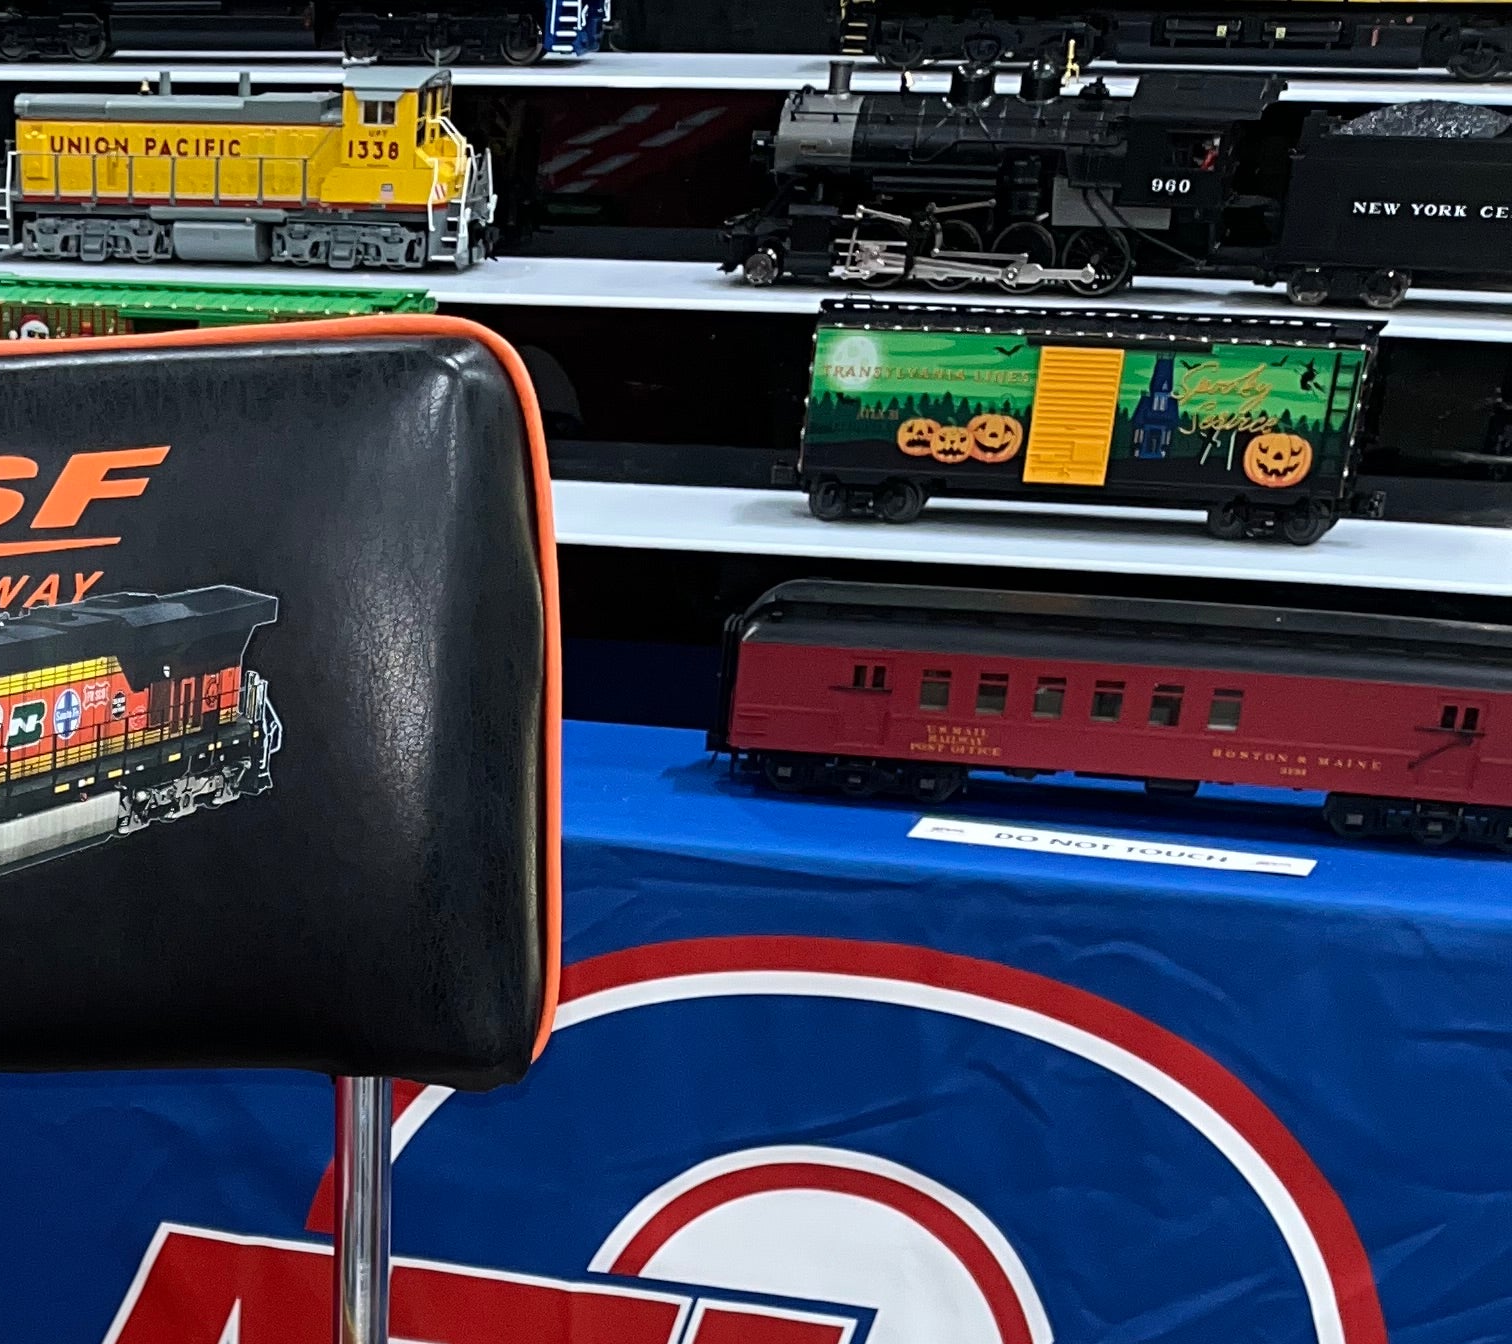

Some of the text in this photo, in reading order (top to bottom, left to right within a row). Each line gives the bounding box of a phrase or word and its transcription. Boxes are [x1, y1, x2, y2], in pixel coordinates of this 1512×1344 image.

[50, 135, 241, 157] UNION PACIFIC
[347, 140, 399, 160] 1338
[1151, 178, 1191, 194] 960
[1352, 201, 1512, 219] NEW YORK CE
[823, 364, 1030, 385] TRANSYLVANIA LINES
[1212, 748, 1288, 763] BOSTON
[1318, 757, 1382, 772] MAINE
[995, 832, 1229, 863] DO NOT TOUCH
